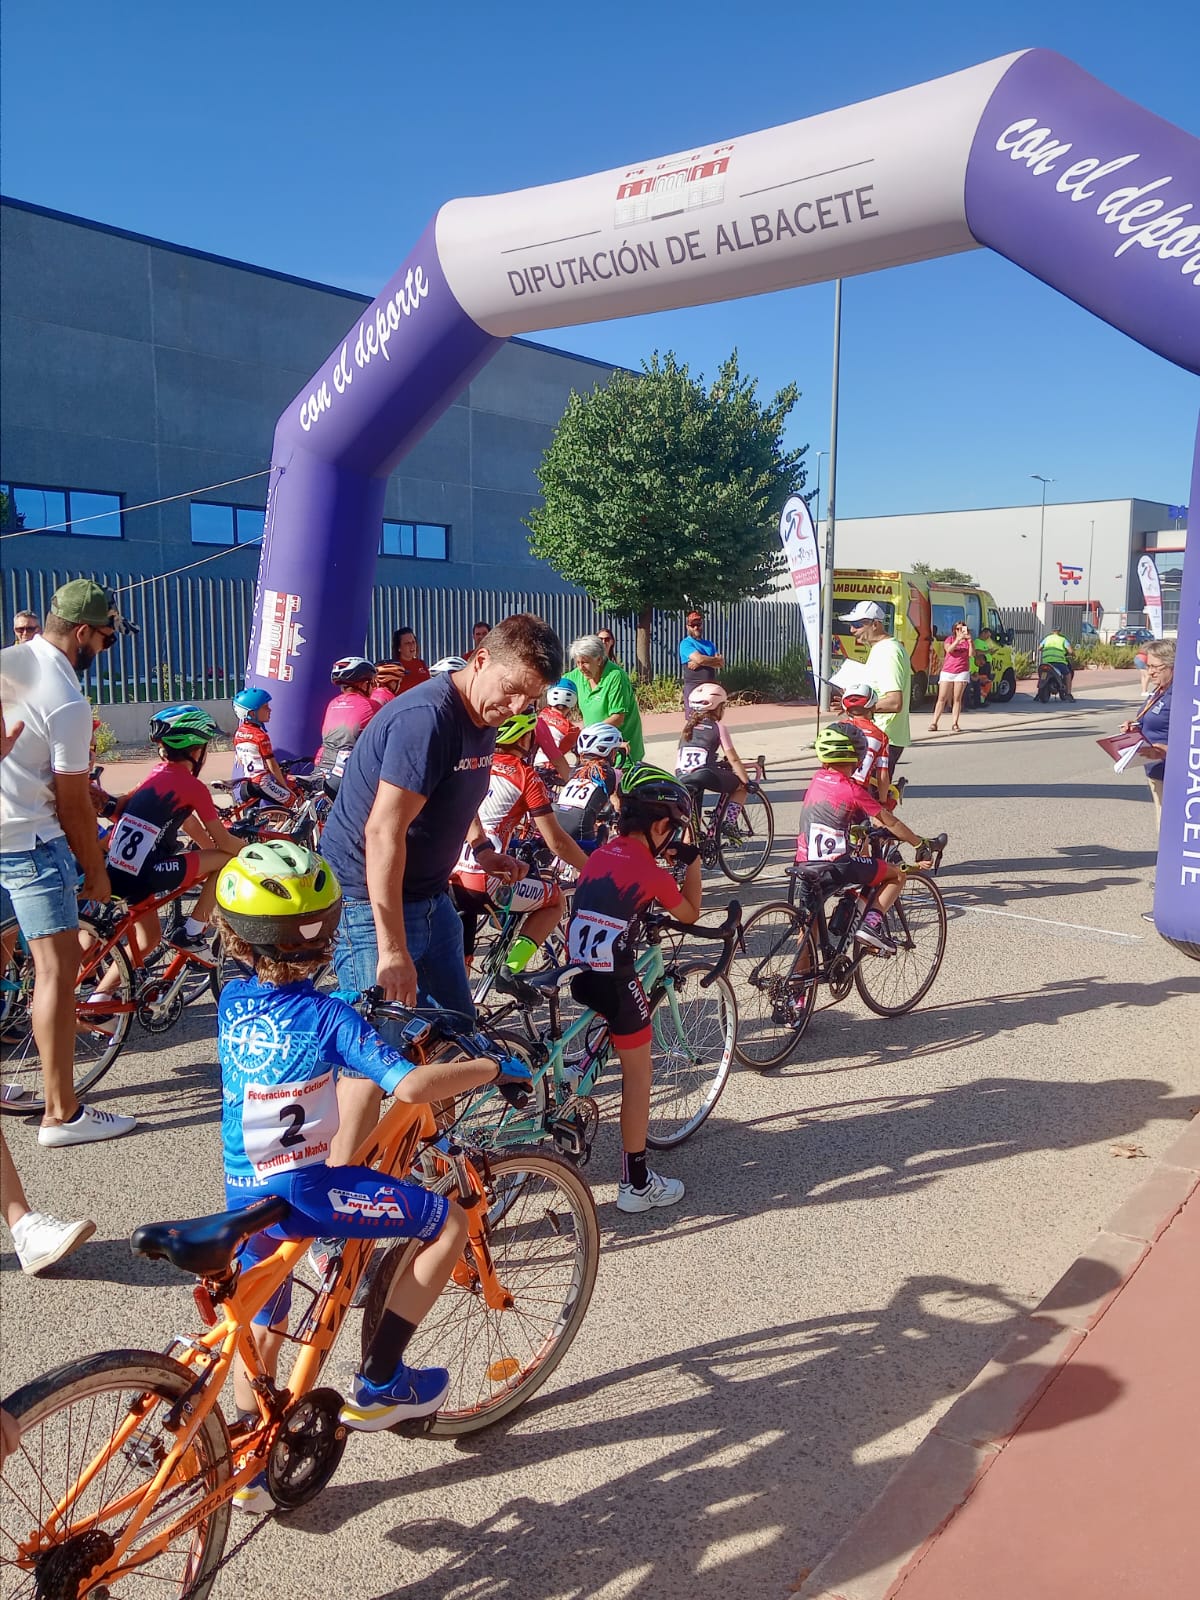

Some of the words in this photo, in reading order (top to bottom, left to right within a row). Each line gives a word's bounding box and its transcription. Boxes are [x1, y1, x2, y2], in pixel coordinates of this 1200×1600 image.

[996, 117, 1073, 176] con
[1056, 153, 1141, 202] el
[507, 240, 661, 297] DIPUTACIÓN
[665, 229, 707, 265] DE
[715, 184, 880, 255] ALBACETE
[1096, 176, 1200, 286] depo
[300, 380, 332, 432] con
[333, 342, 353, 394] el
[355, 265, 429, 368] deporte
[684, 752, 702, 768] 33
[565, 784, 590, 800] 173
[115, 825, 144, 861] 78
[815, 833, 836, 858] 19
[627, 980, 649, 1021] ONTUR
[248, 1089, 291, 1101] Federación
[292, 1088, 303, 1098] de
[279, 1103, 307, 1148] 2
[305, 1141, 328, 1158] Mancha
[348, 1201, 399, 1212] MILLA
